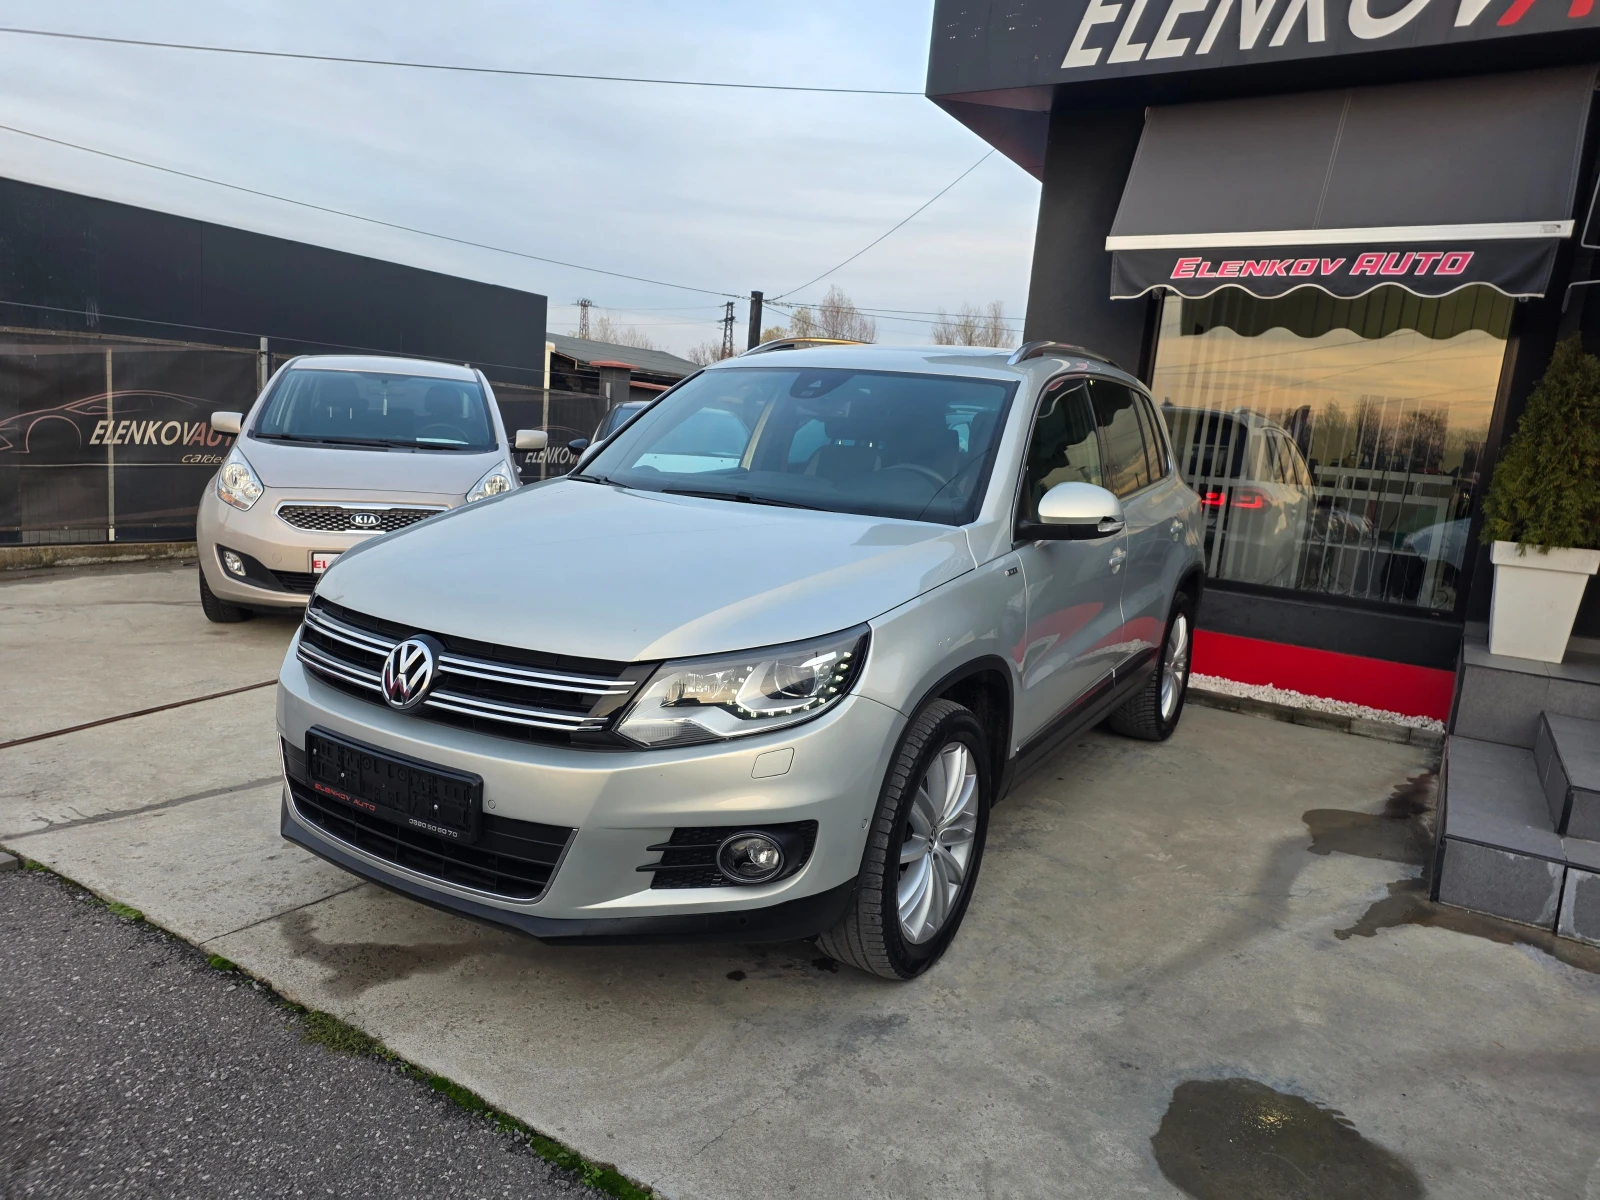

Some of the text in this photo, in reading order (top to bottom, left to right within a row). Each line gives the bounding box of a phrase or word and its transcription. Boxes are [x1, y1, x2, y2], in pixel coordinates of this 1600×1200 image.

[1170, 251, 1475, 279] ELENKOV AUTO
[355, 515, 377, 524] KIA
[314, 783, 376, 811] ELENKOV AUTO
